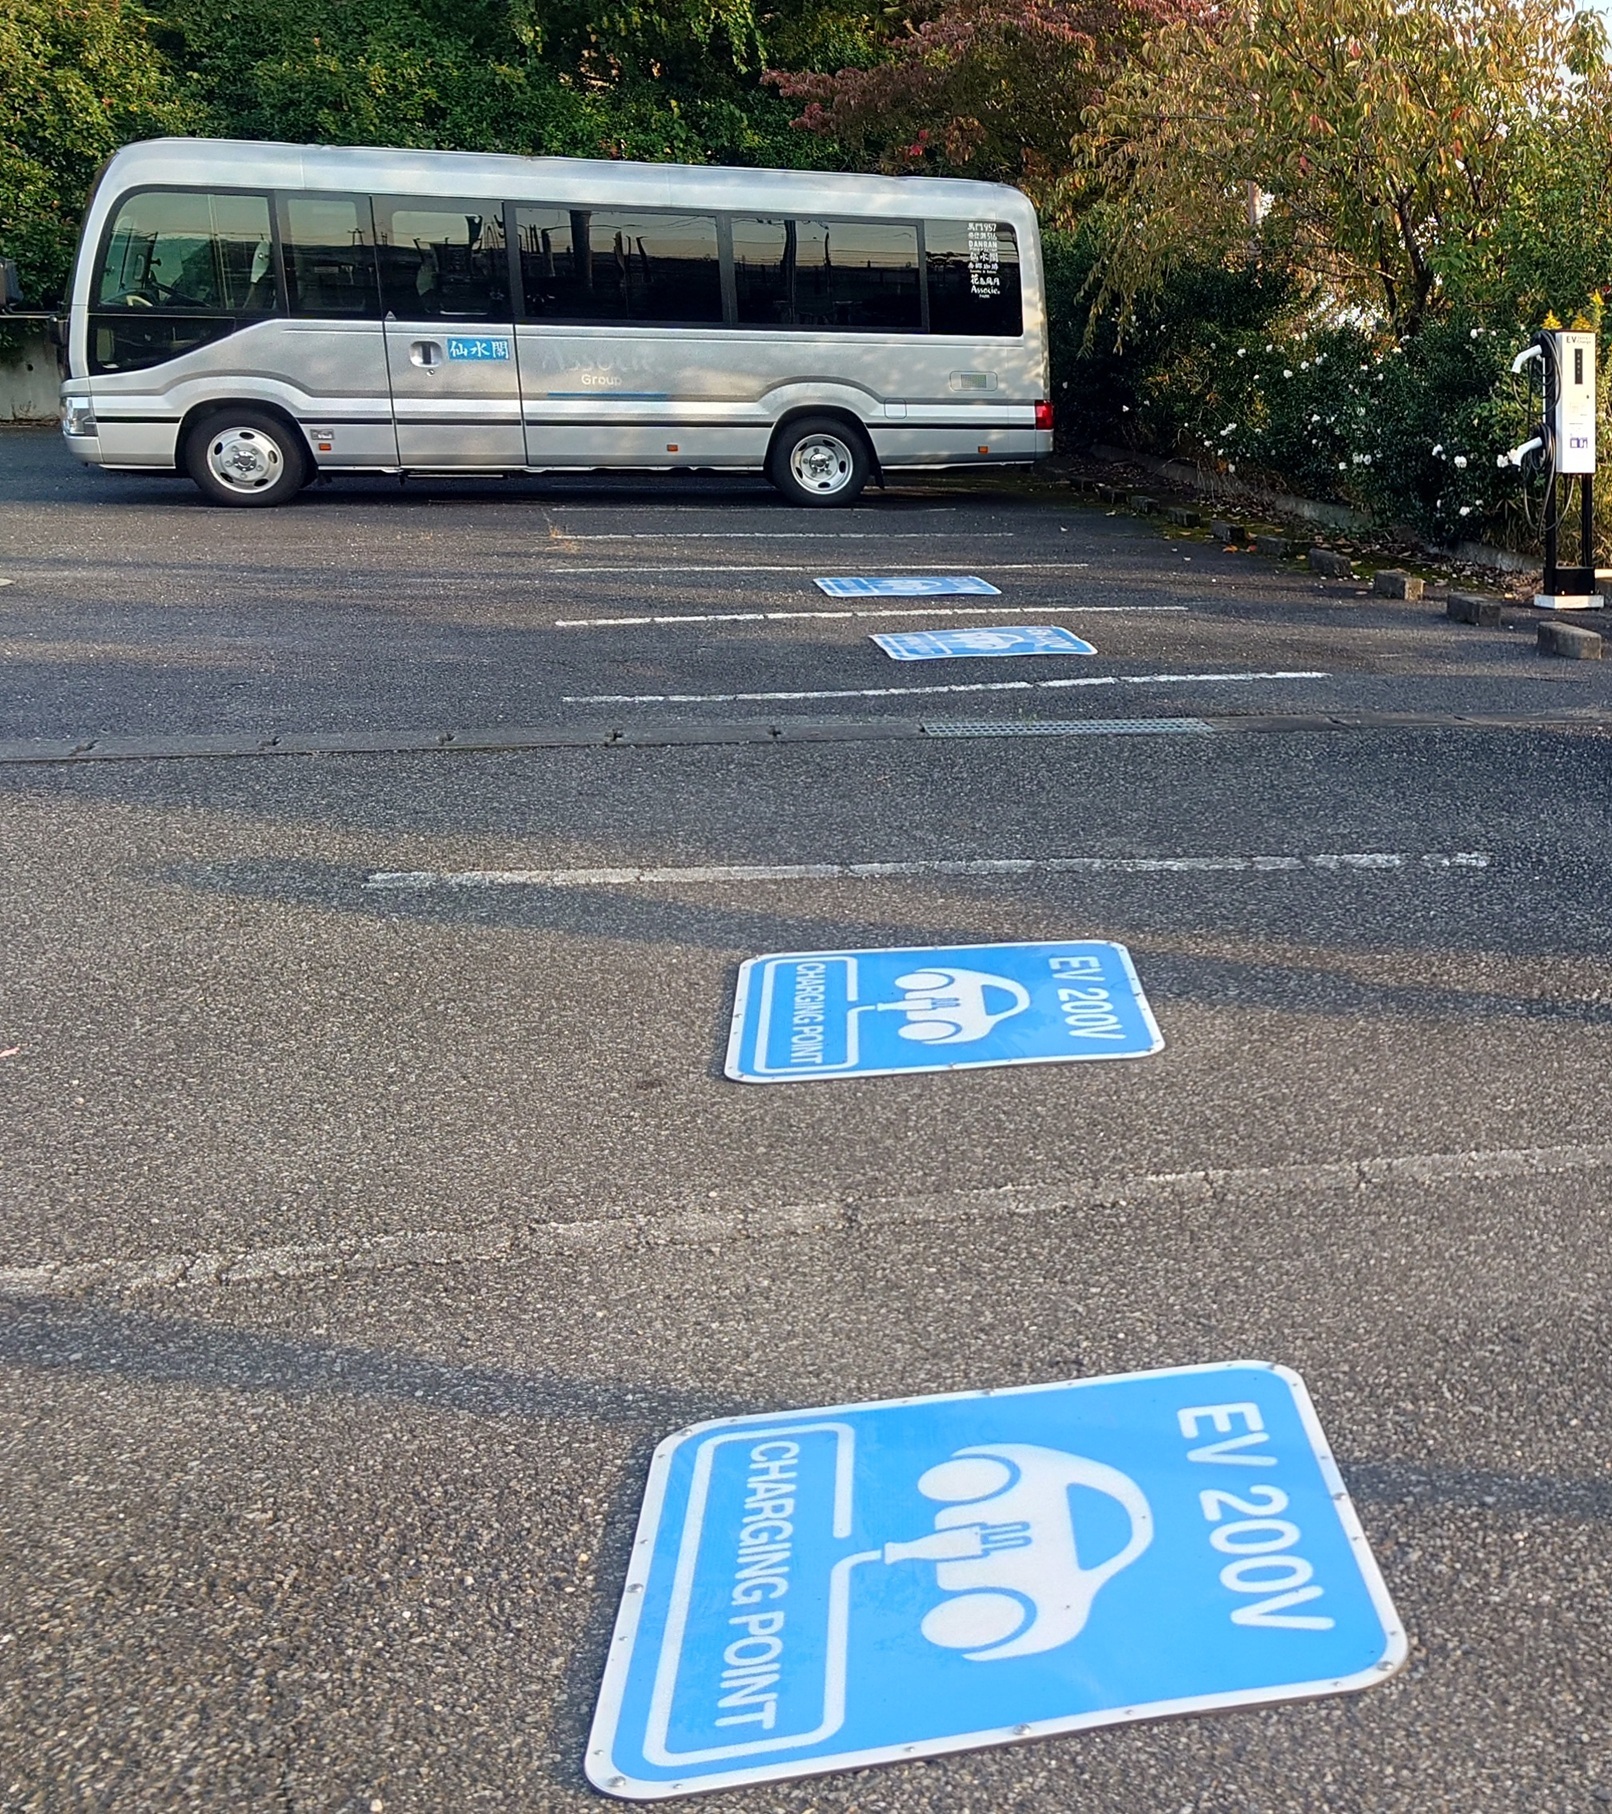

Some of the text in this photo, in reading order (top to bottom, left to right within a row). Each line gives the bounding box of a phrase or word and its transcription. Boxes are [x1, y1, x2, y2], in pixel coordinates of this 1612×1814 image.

[581, 374, 623, 387] Group
[1566, 336, 1577, 344] EV
[788, 962, 826, 1065] CHARGING POINT
[1048, 955, 1126, 1040] EV 200V
[1176, 1401, 1335, 1631] EV 200V
[714, 1440, 800, 1731] CHARGING POINT
